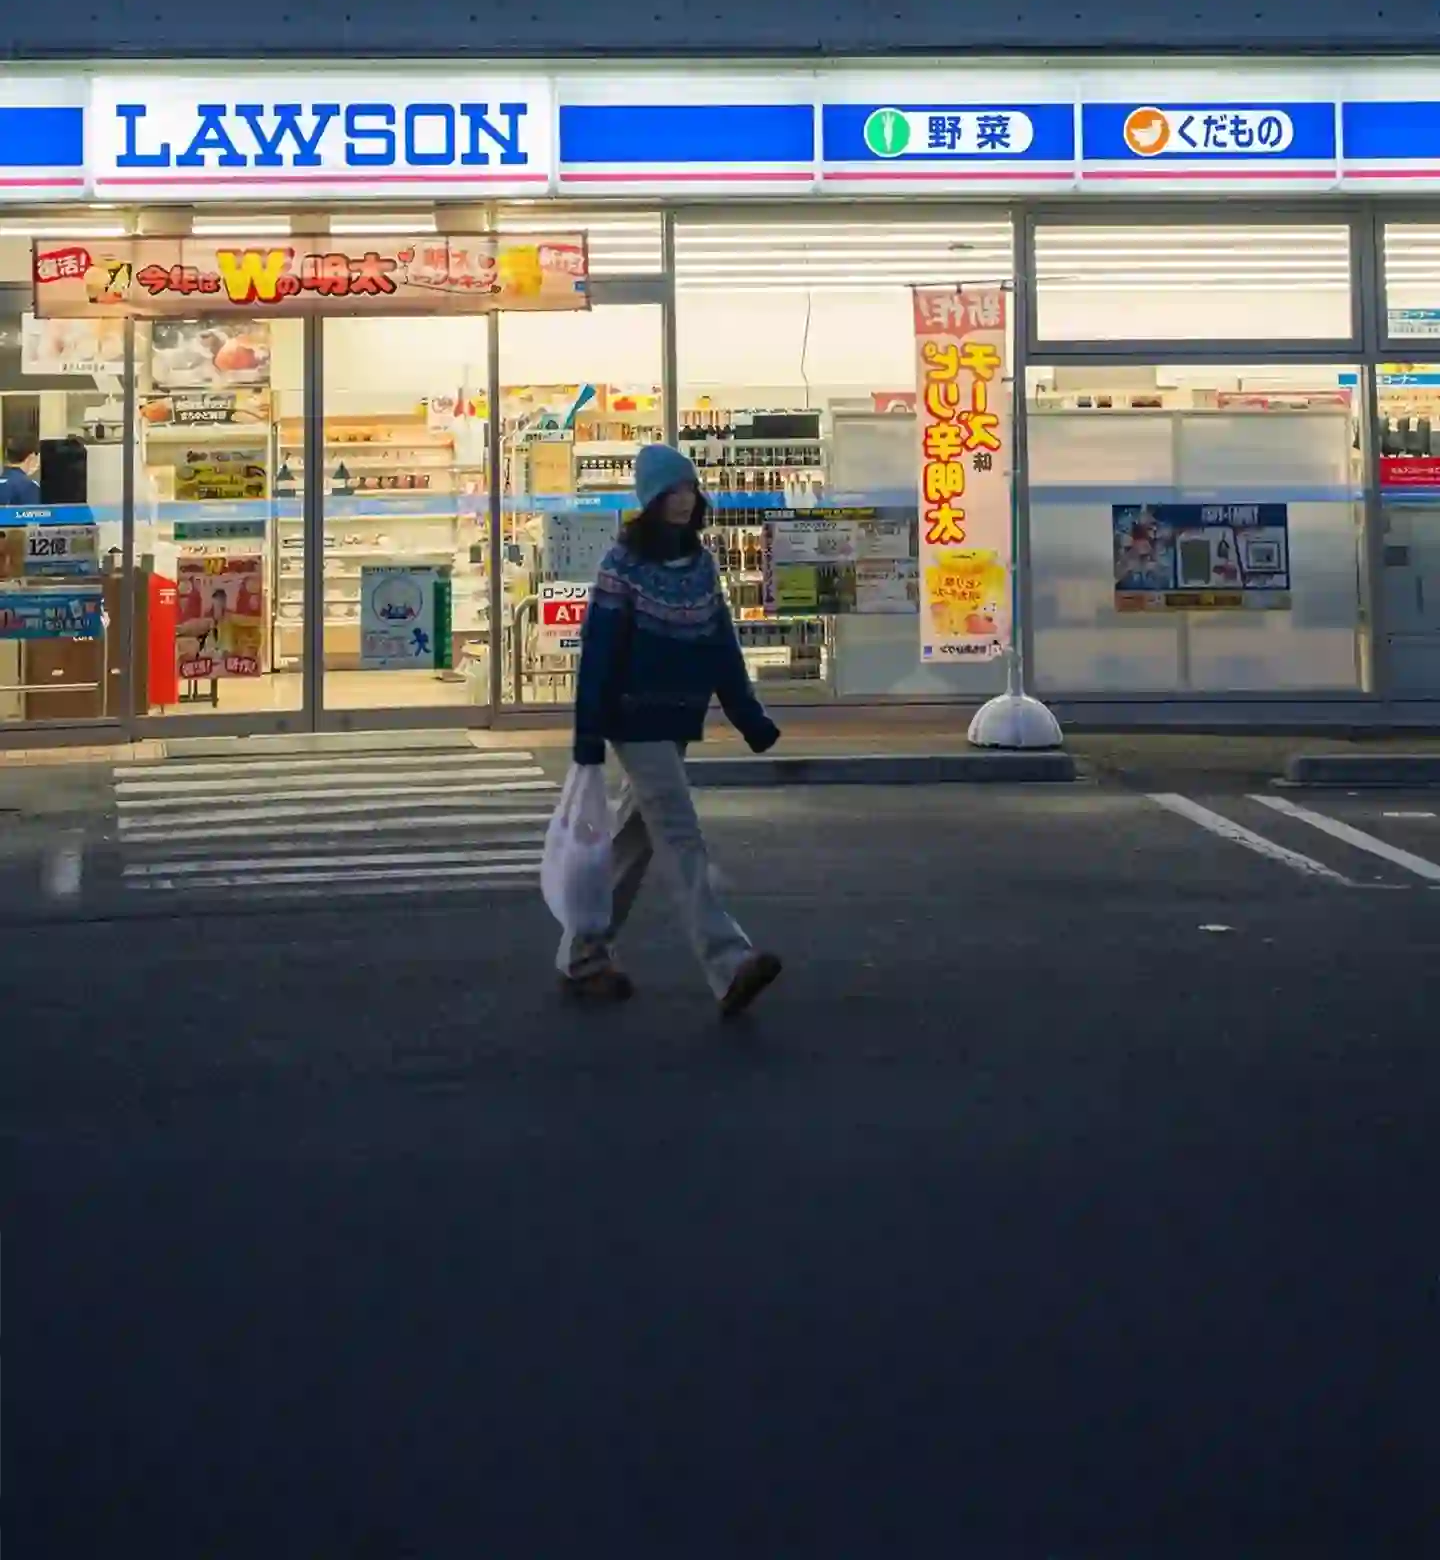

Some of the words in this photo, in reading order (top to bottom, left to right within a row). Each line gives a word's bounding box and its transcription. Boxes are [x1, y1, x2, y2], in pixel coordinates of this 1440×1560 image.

[116, 103, 528, 167] LAWSON
[928, 115, 1011, 150] 野菜
[1177, 114, 1283, 148] くだもの
[555, 604, 586, 622] AT
